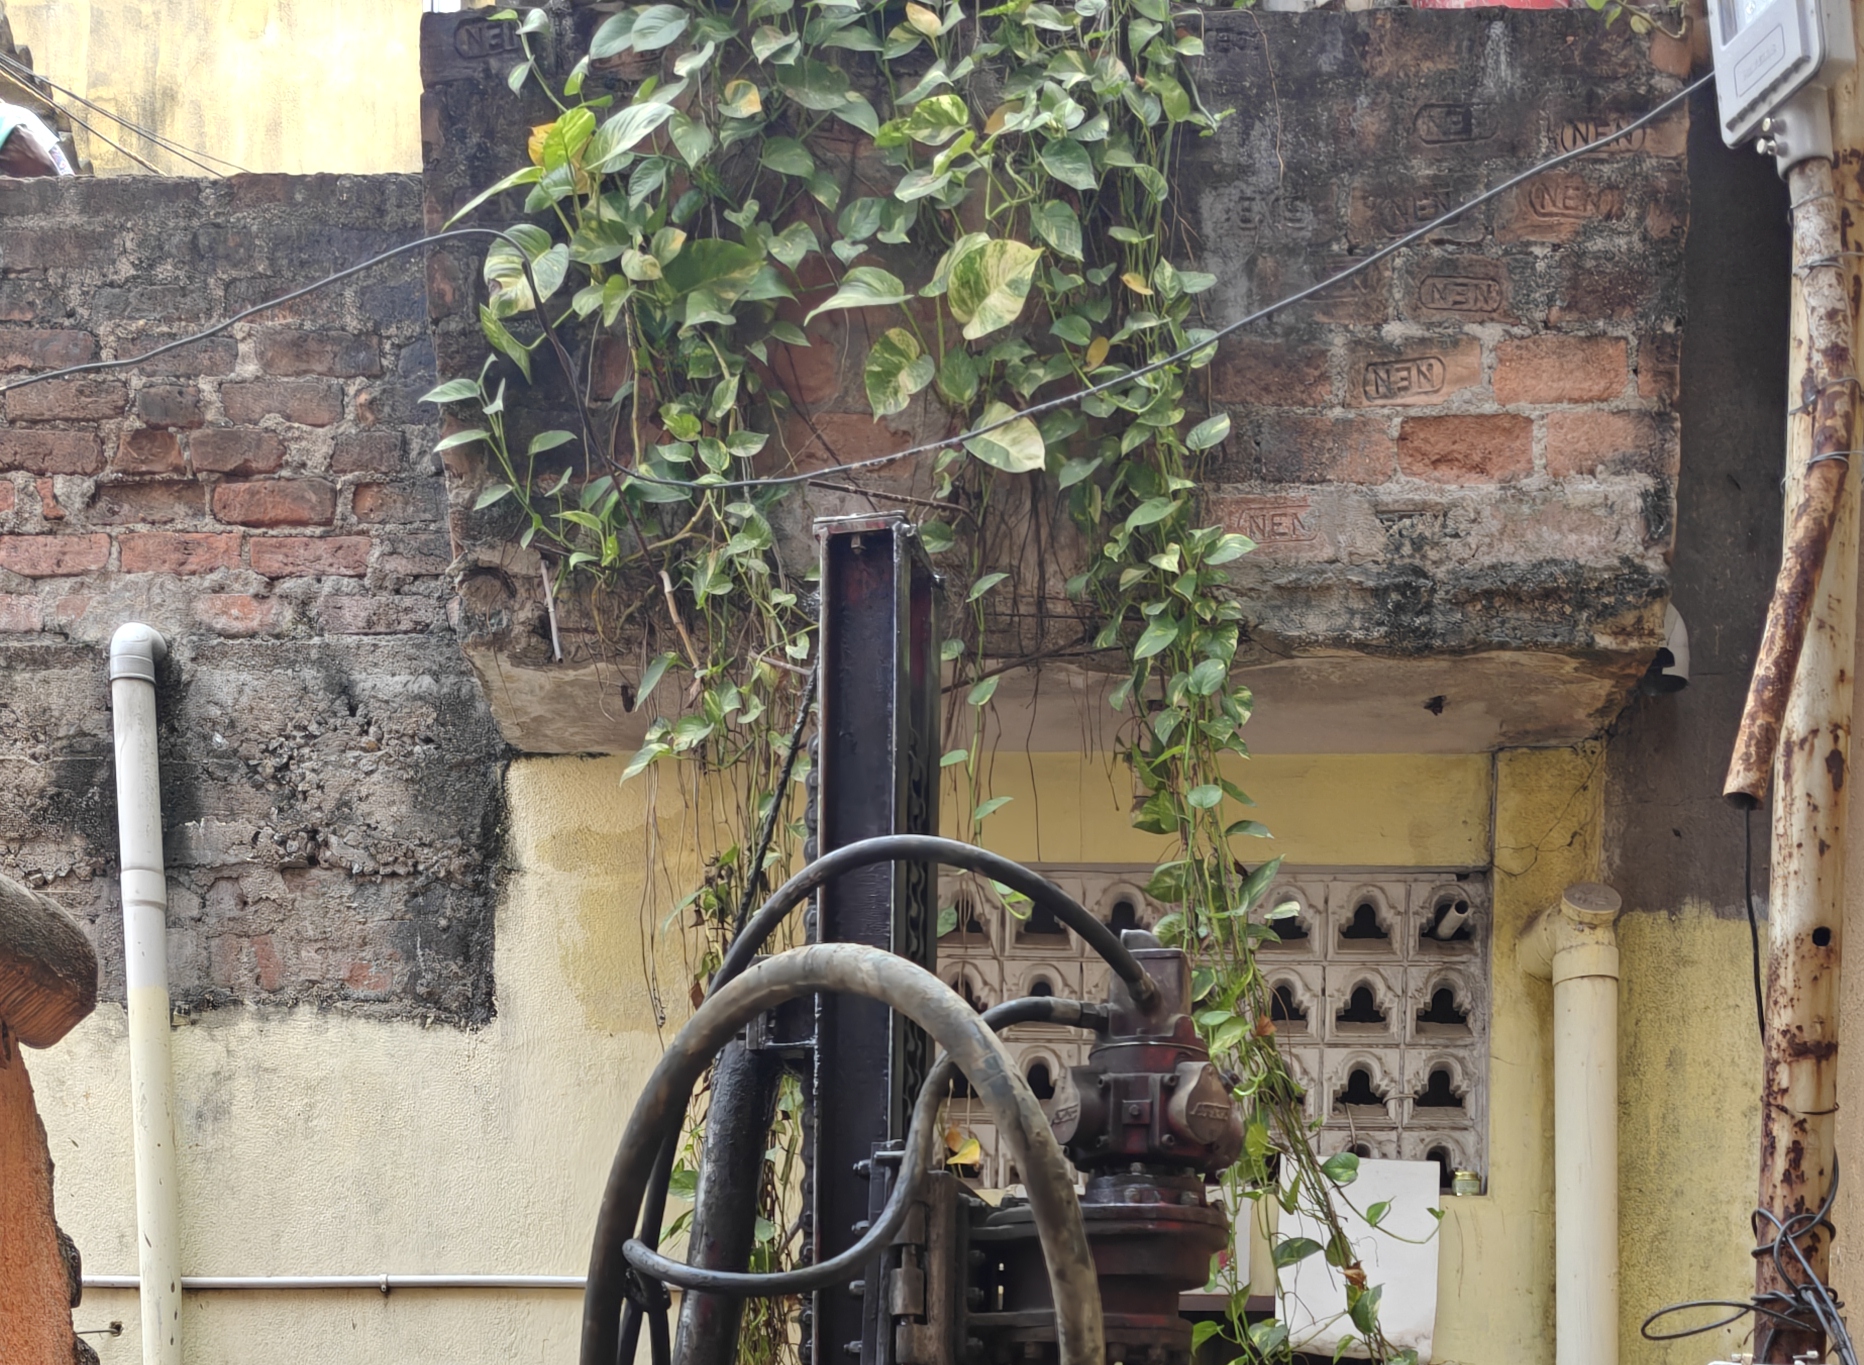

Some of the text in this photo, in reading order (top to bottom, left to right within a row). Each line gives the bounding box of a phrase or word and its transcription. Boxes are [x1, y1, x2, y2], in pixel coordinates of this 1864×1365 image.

[1571, 118, 1633, 148] NEN
[1431, 282, 1491, 306] NEN
[1373, 362, 1435, 396] NEN
